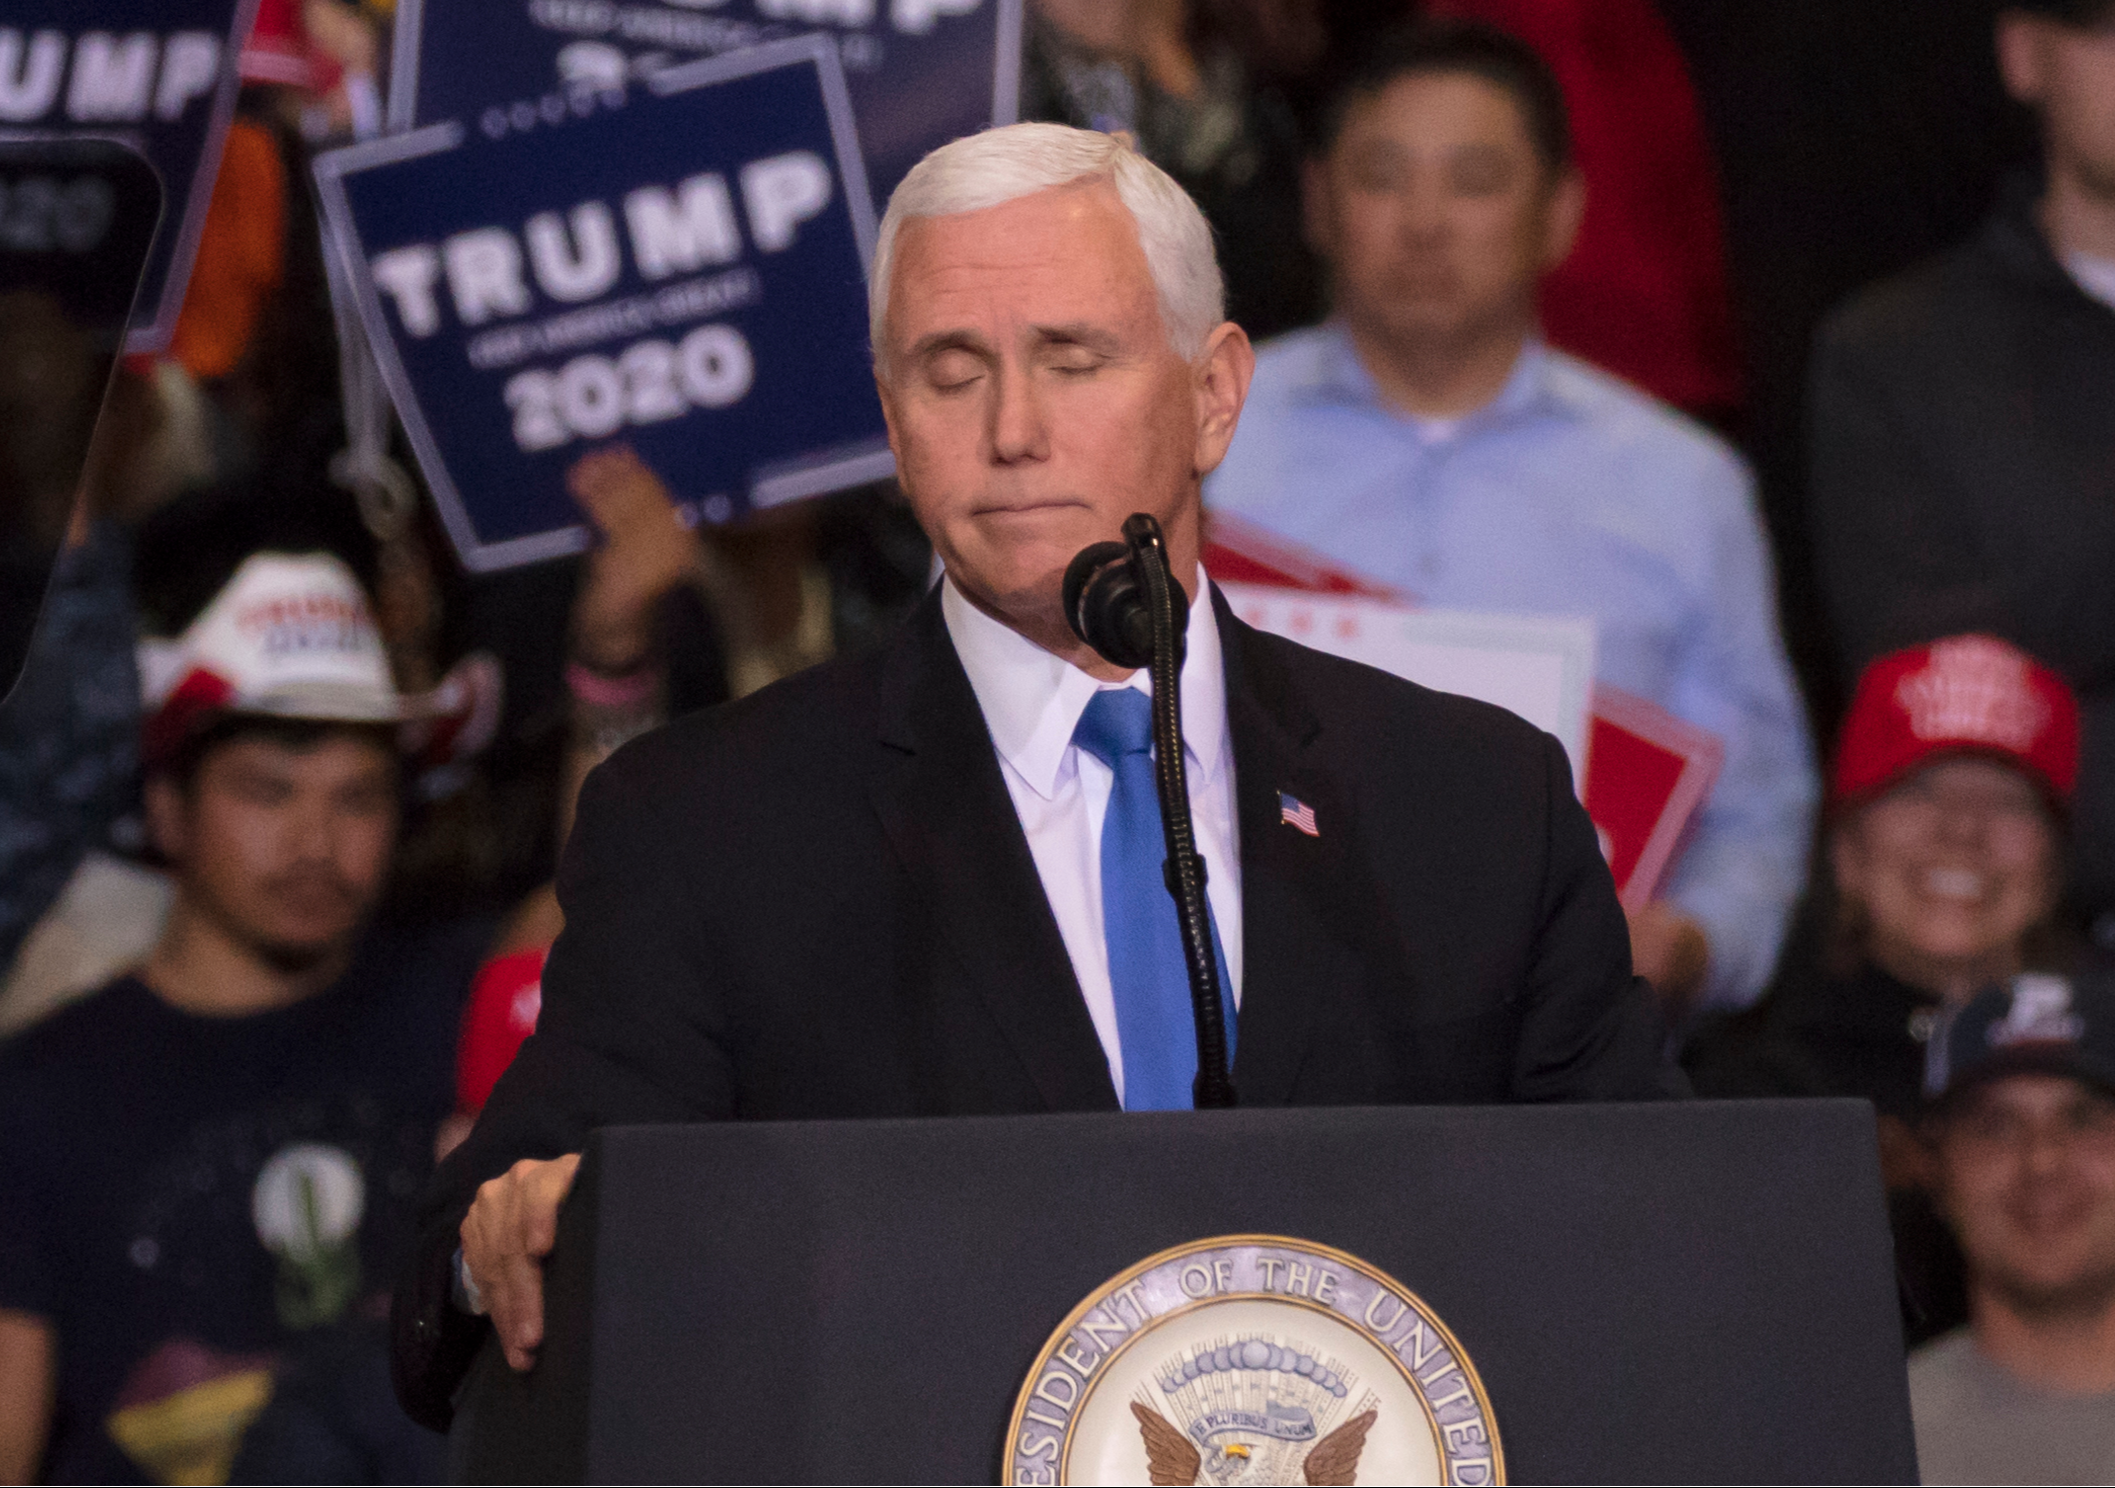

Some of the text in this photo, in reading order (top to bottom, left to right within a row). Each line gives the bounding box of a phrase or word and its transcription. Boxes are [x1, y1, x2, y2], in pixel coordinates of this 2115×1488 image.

[372, 151, 831, 337] TRUMP
[504, 323, 755, 452] 2020
[1017, 1257, 1491, 1486] ESIDENT OF THE UNITED
[1195, 1412, 1313, 1436] E PLURIBUS UNUM
